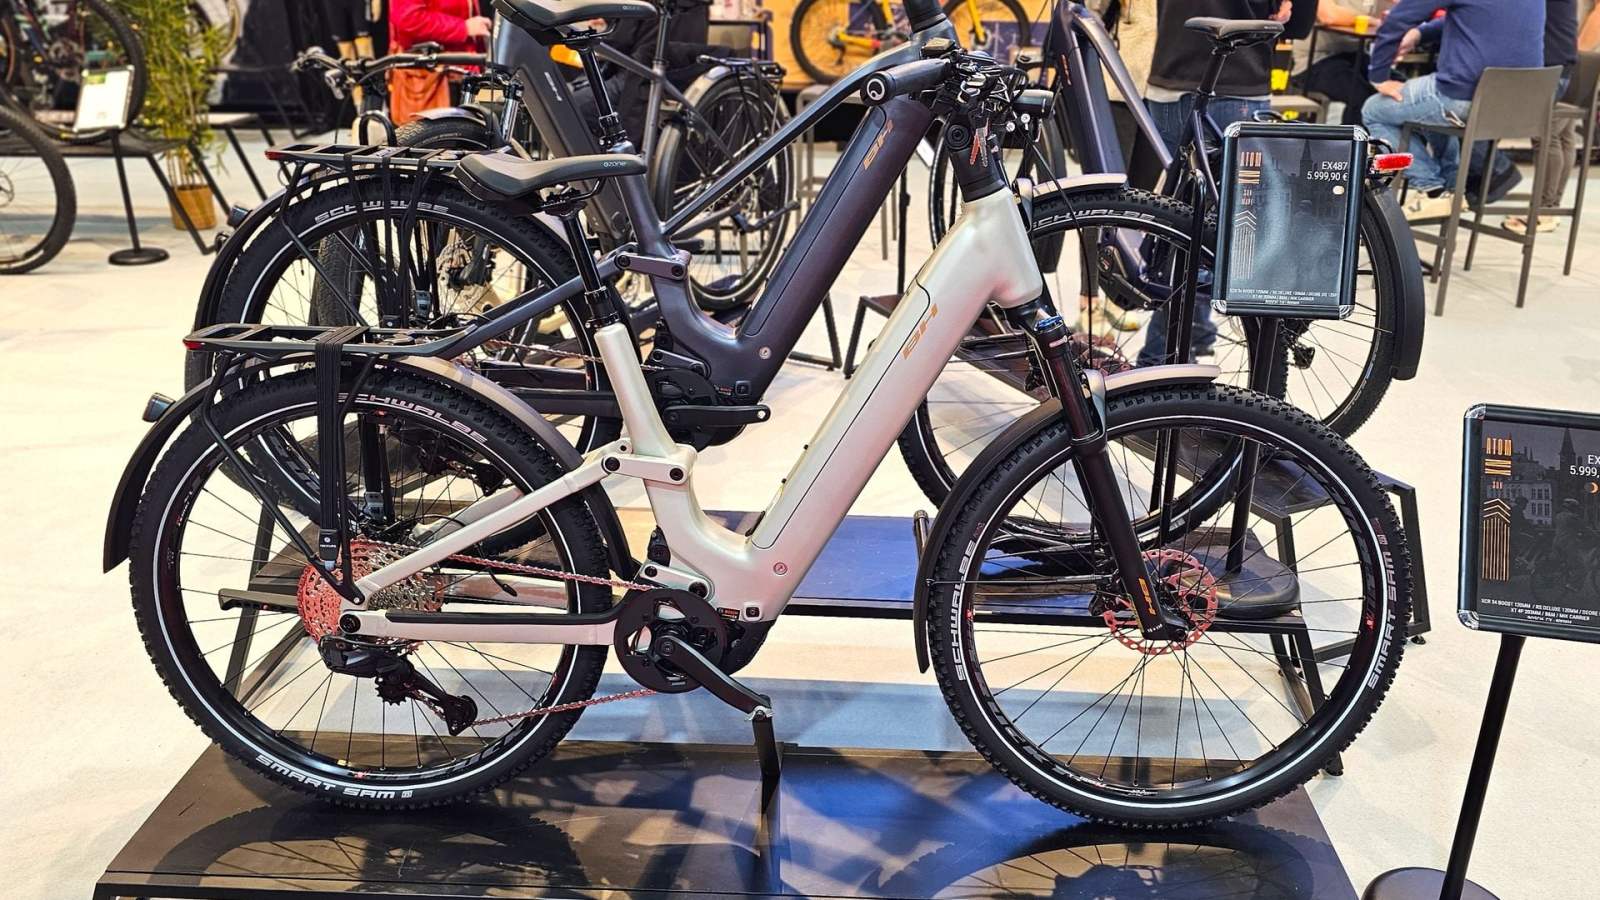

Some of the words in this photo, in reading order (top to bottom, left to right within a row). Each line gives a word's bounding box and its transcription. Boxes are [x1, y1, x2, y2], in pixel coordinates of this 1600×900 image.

[1306, 171, 1341, 182] 5.999,90
[1342, 172, 1348, 181] €
[1321, 161, 1349, 171] EX487
[902, 303, 938, 360] BH
[1486, 437, 1512, 457] ATOM
[950, 539, 977, 681] SCHWALBE
[1367, 609, 1396, 690] SMART
[1382, 551, 1397, 602] SAM
[255, 754, 336, 791] SMART
[342, 788, 396, 799] SAM
